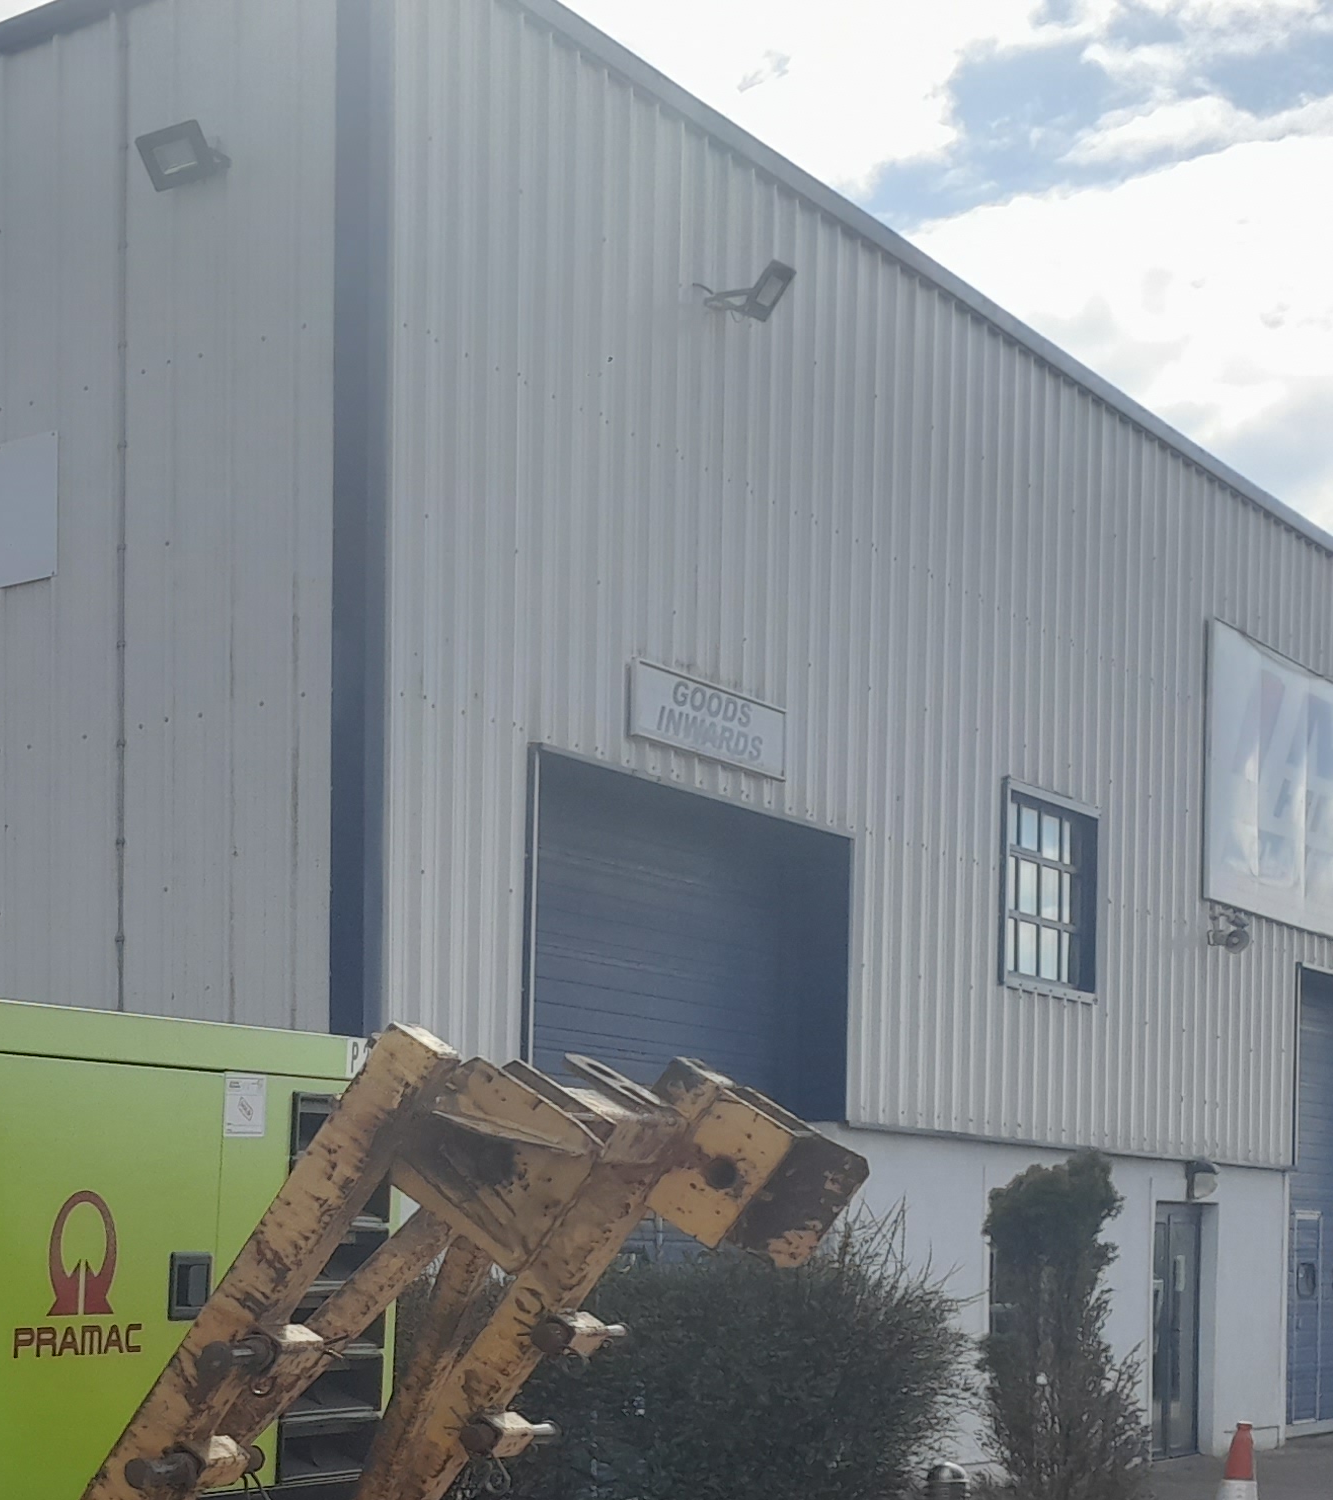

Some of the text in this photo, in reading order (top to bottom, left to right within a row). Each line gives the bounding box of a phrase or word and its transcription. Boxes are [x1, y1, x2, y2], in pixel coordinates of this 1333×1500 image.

[673, 680, 753, 728] GOODS
[656, 705, 764, 761] INWARDS
[13, 1323, 142, 1359] PRAMAC
